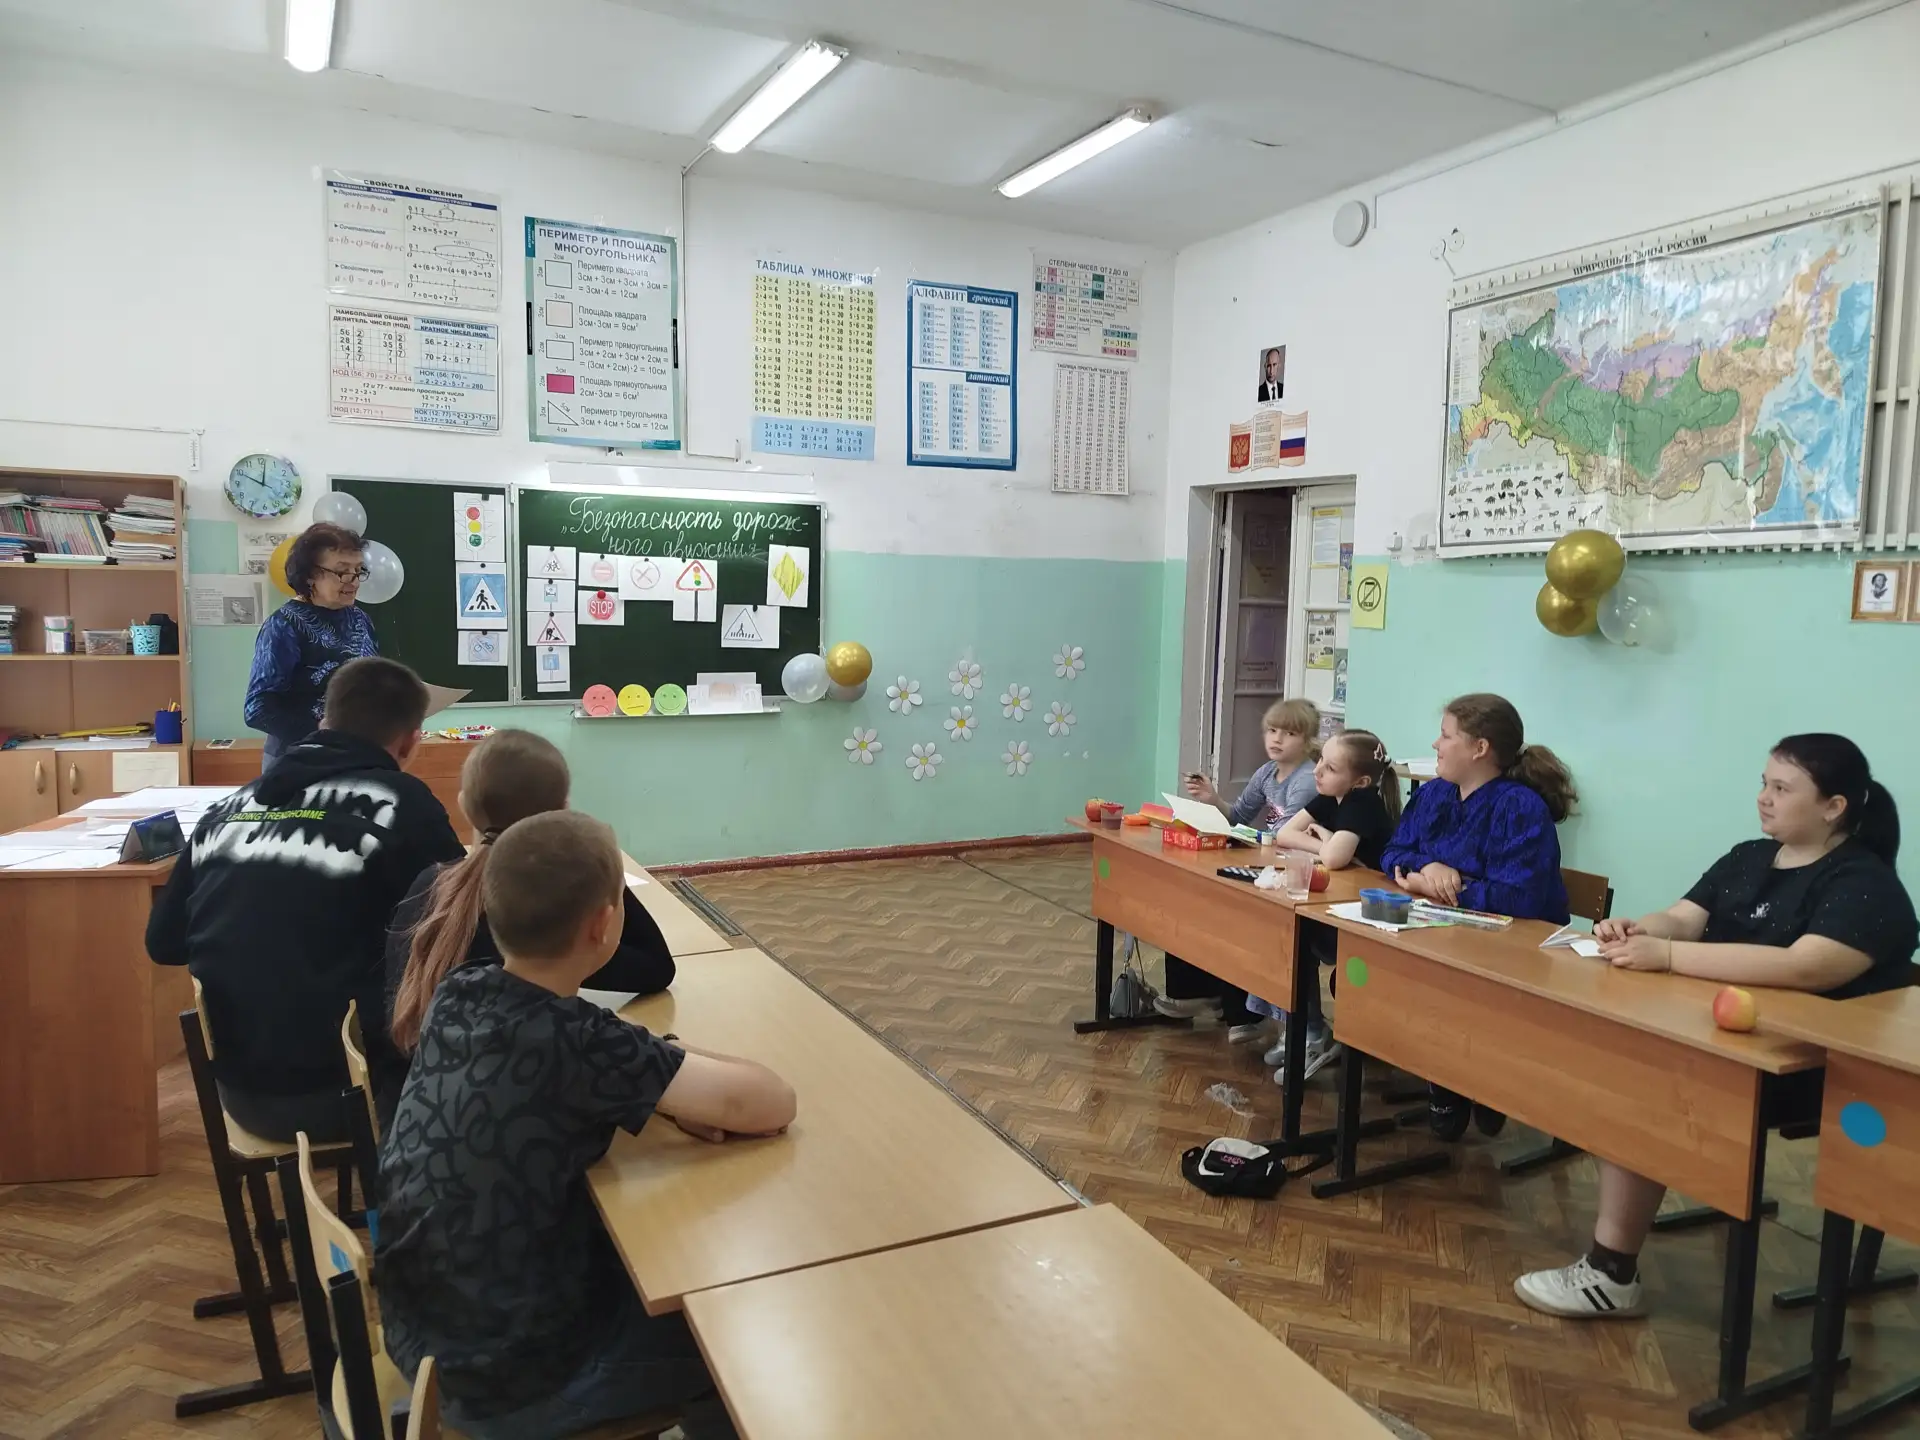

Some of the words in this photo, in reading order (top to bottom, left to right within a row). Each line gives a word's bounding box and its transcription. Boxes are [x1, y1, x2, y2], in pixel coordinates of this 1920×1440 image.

[363, 179, 410, 192] СВОЙСТВА
[414, 187, 463, 199] СЛОЖЕНИЯ
[539, 227, 598, 244] ПЕРИМЕТР
[602, 237, 609, 247] И
[612, 238, 668, 254] ПЛОЩАДЬ
[1666, 235, 1708, 252] РОССИИ
[554, 241, 657, 264] МНОГОУГОЛЬНИКА
[577, 260, 614, 274] Периметр
[616, 267, 649, 278] квадрата
[756, 259, 805, 275] ТАБЛИЦА
[577, 272, 593, 282] 3см
[601, 275, 616, 285] 3см
[624, 278, 639, 288] 3см
[647, 280, 661, 291] 3см
[621, 289, 638, 300] 12см
[914, 287, 966, 302] АЛФАВИТ
[332, 315, 369, 326] ДЕЛИТЕЛЬ
[335, 308, 383, 321] НАИБОЛЬШИЙ
[577, 305, 613, 320] Площадь
[615, 310, 648, 322] квадрата
[340, 328, 350, 337] 56
[383, 332, 393, 341] 70
[578, 335, 613, 349] Периметр
[615, 341, 669, 354] прямоугольника
[578, 347, 594, 357] 3см
[602, 349, 617, 359] 2см
[625, 352, 640, 363] 3см
[648, 354, 662, 364] 2см
[649, 365, 667, 376] 10см
[578, 375, 612, 390] Площадь
[614, 380, 668, 392] прямоугольника
[580, 405, 618, 419] Периметр
[620, 410, 669, 421] треугольника
[580, 417, 596, 427] 3см
[604, 418, 618, 428] 4см
[626, 420, 641, 430] 5см
[651, 422, 669, 432] 12см
[246, 460, 253, 469] 11
[257, 457, 265, 466] 12
[272, 460, 277, 469] 1
[236, 468, 244, 477] 10
[281, 469, 287, 477] 2
[235, 480, 240, 488] 9
[285, 480, 291, 489] 3
[239, 491, 245, 500] 8
[249, 499, 254, 510] 7
[262, 503, 267, 511] 6
[732, 511, 809, 542] дорож-
[608, 537, 653, 556] ного
[590, 600, 614, 614] STOP
[225, 811, 263, 822] LEADING
[263, 808, 327, 821] TRENDHOMME
